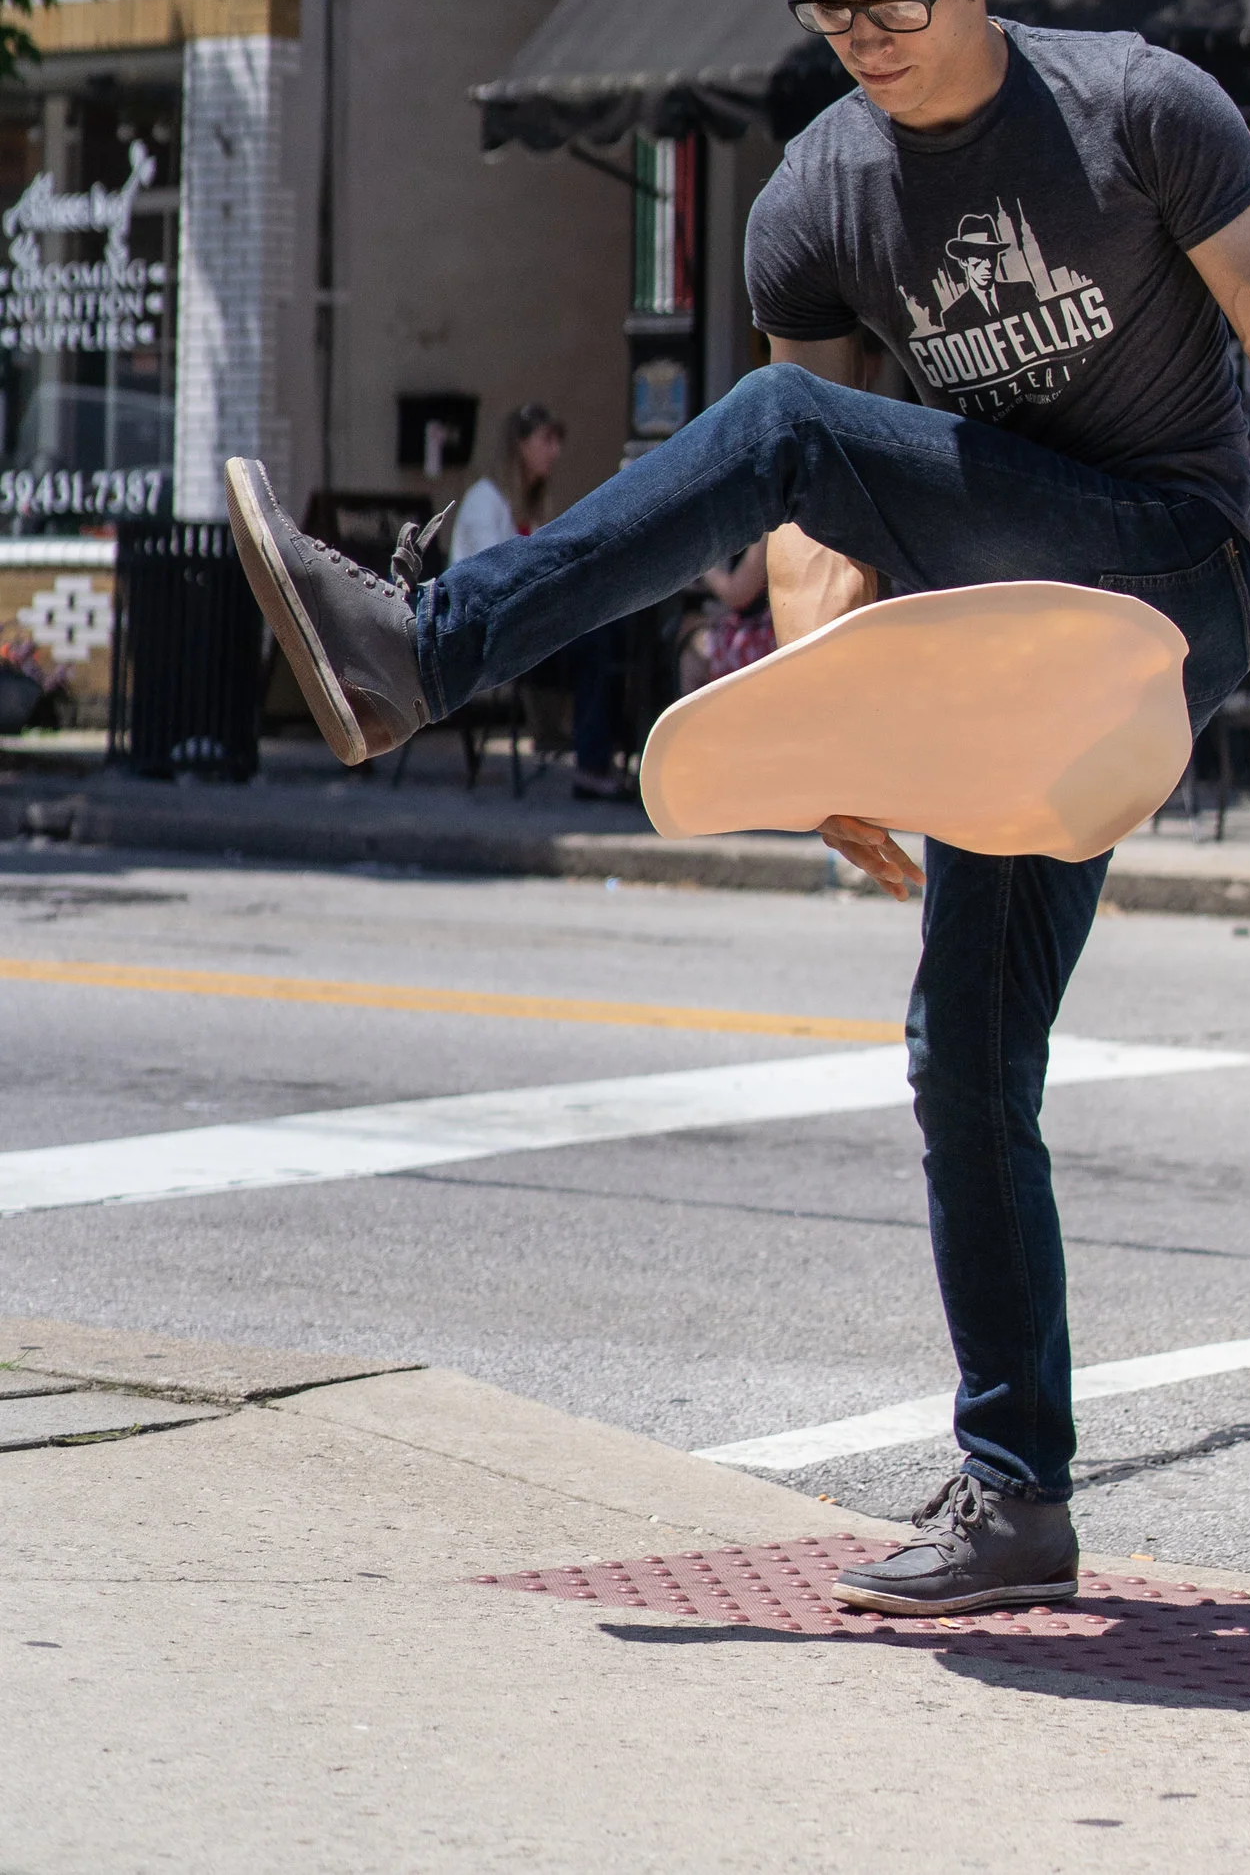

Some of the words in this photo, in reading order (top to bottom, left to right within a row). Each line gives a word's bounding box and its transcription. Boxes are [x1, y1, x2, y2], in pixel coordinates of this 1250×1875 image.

[11, 258, 148, 293] GROOMING
[5, 290, 146, 323] NUTRITION
[19, 318, 137, 354] SUPPLIES
[909, 287, 1114, 388] GOODFELLAS
[958, 357, 1086, 415] PIZZERI
